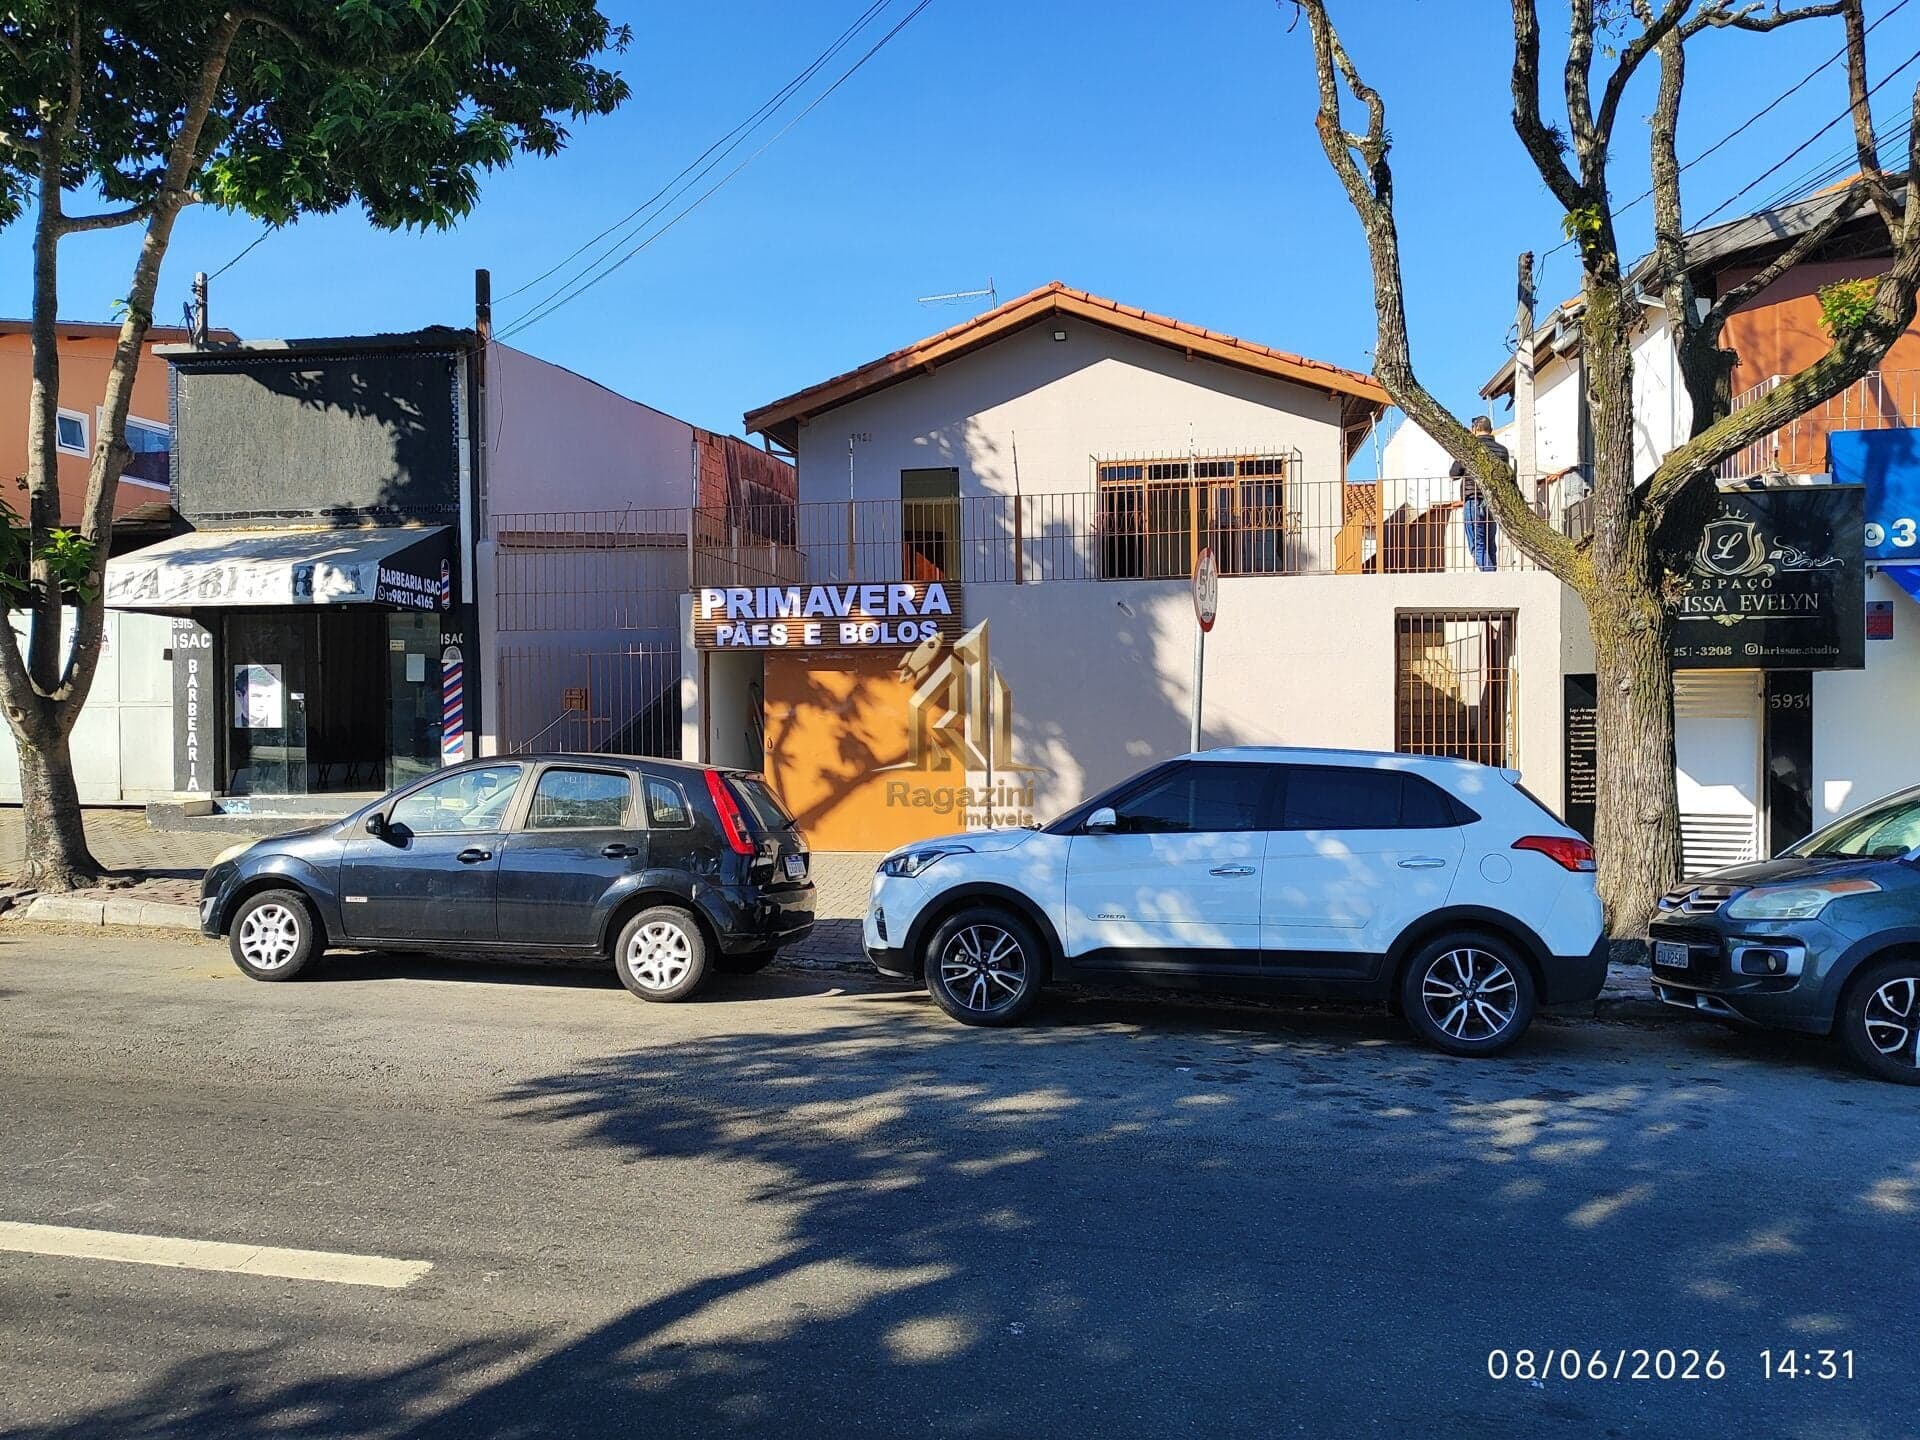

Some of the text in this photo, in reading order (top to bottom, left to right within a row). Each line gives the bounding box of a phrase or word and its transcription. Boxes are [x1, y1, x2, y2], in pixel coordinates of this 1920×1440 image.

[380, 567, 441, 596] BARBEARIA ISAC
[700, 583, 952, 619] PRIMAVERA
[1740, 592, 1820, 612] EVELYN
[172, 618, 193, 629] 5915
[716, 621, 939, 647] PÃES E BOLOS
[173, 633, 211, 649] ISAC
[1771, 693, 1811, 709] 5931
[186, 658, 200, 792] BARBEARIA
